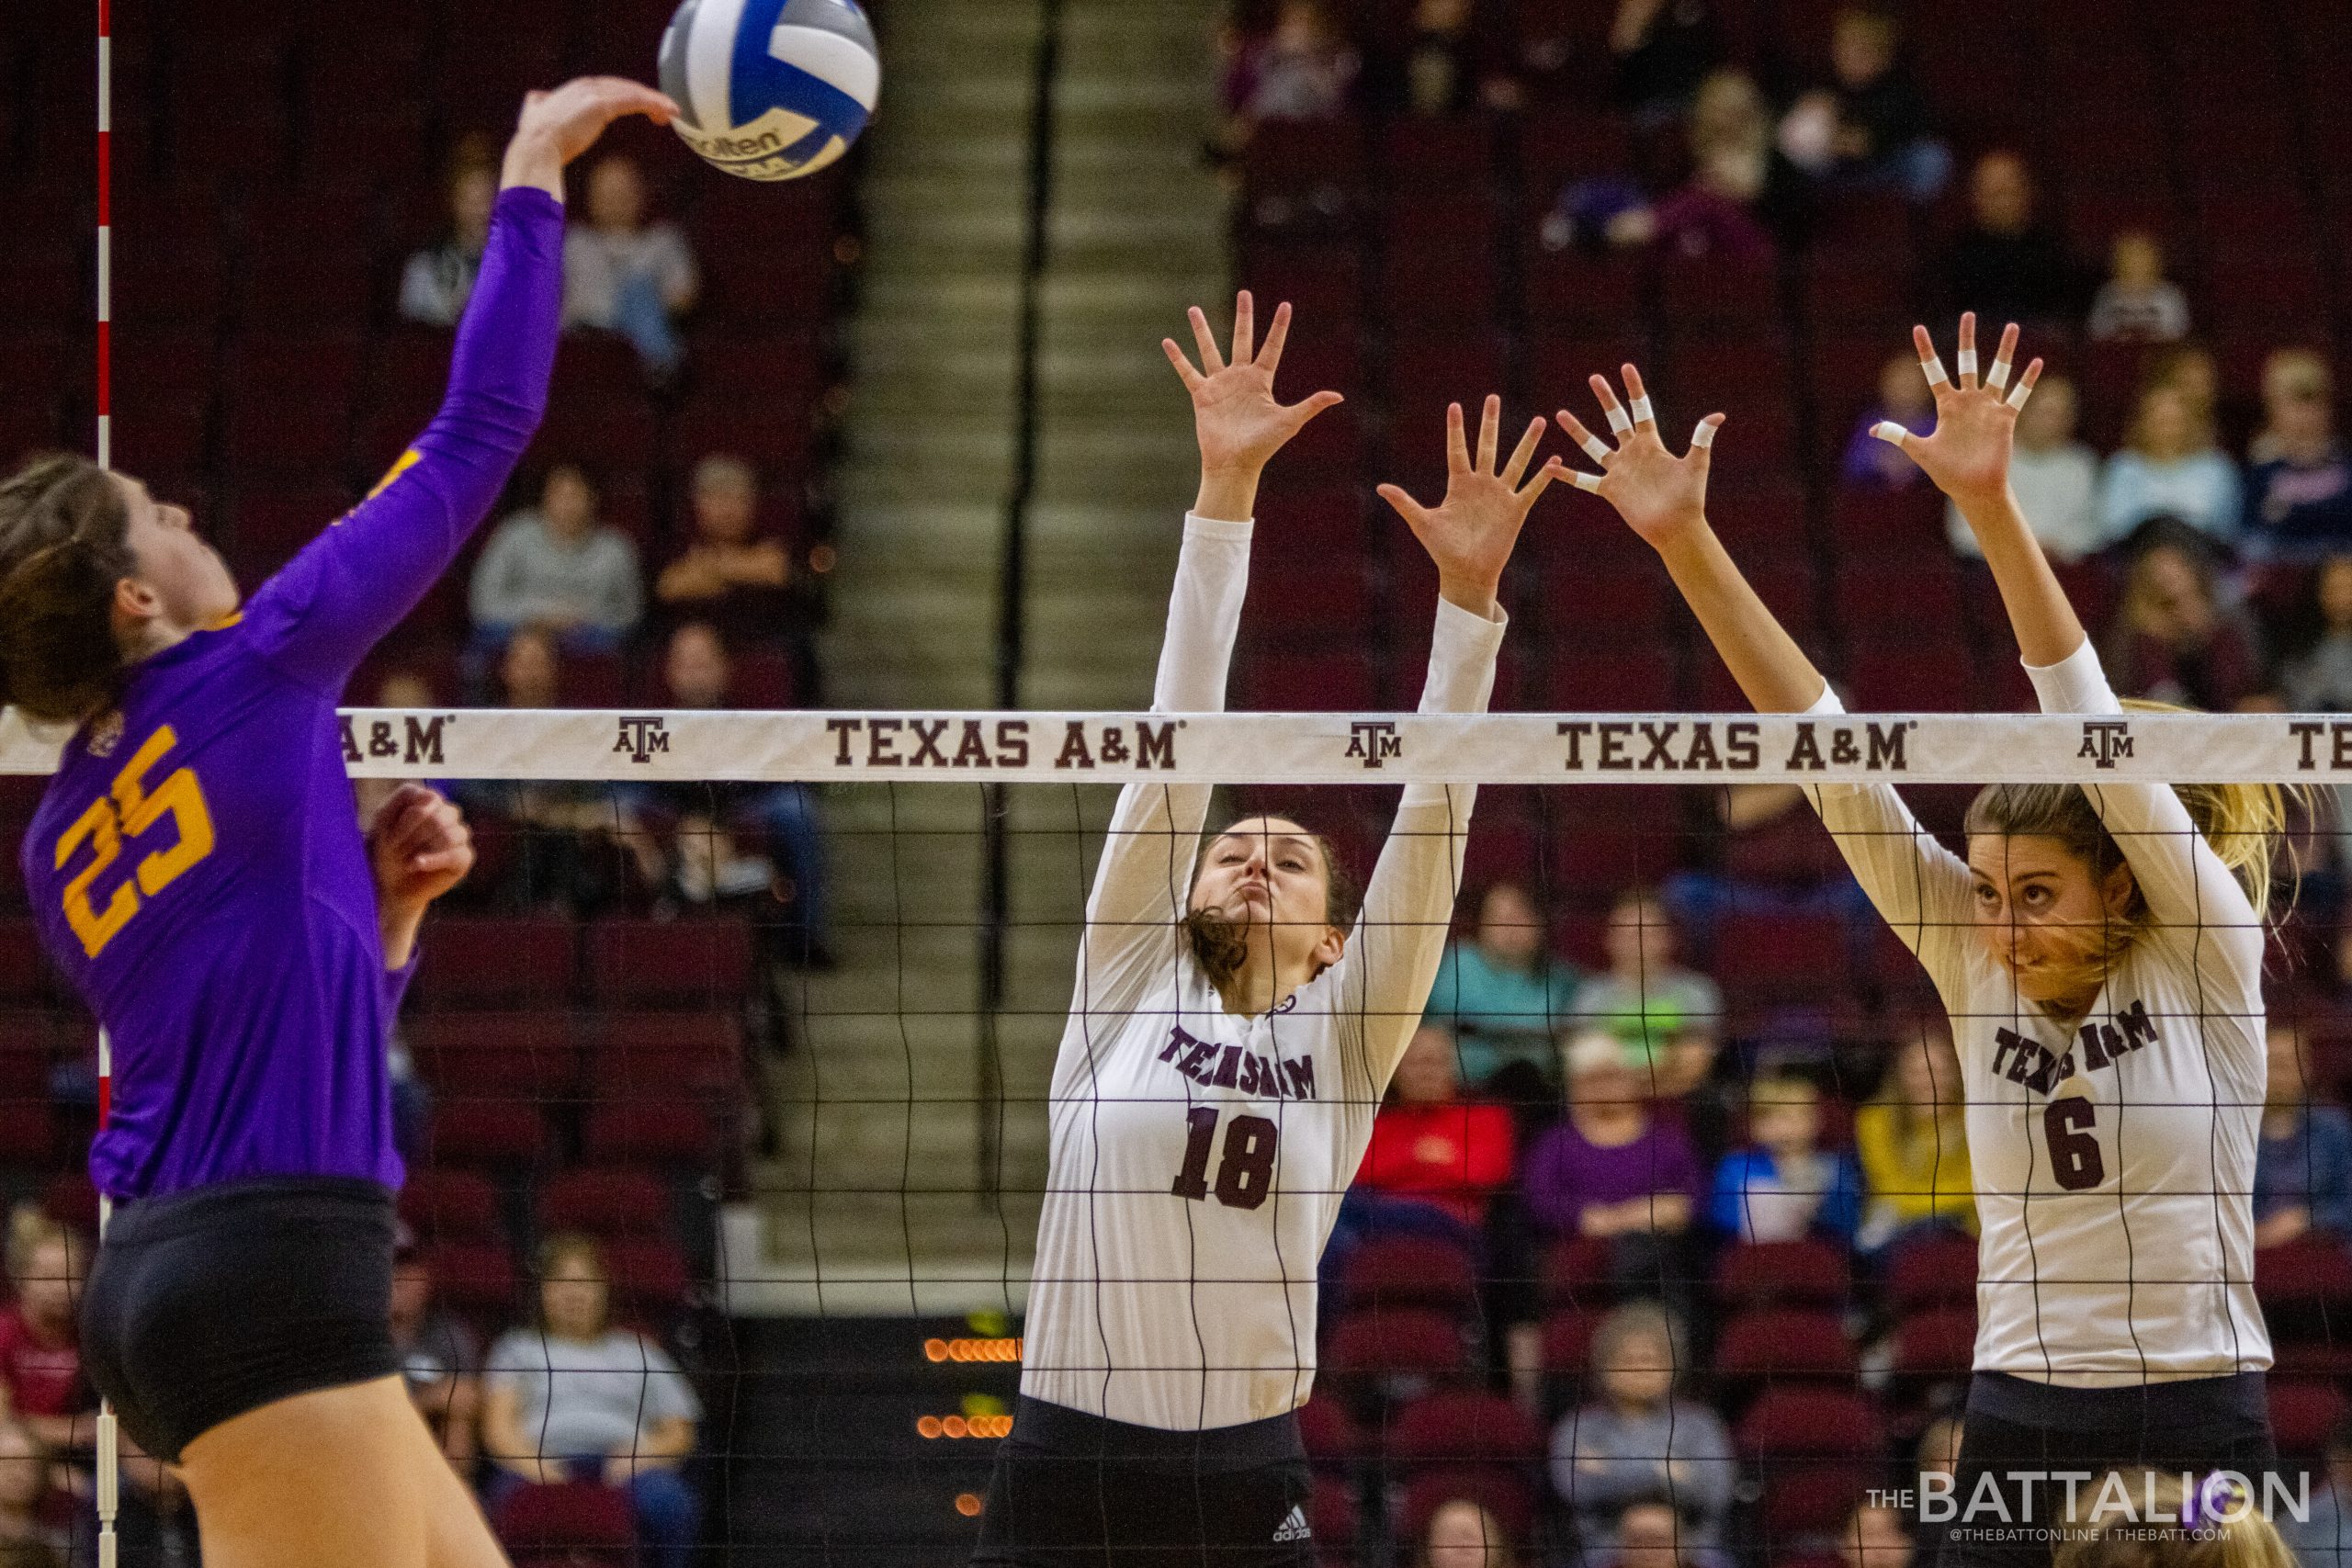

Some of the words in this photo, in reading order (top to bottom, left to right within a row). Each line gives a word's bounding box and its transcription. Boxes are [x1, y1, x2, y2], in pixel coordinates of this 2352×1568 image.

[826, 718, 1030, 769] TEXAS
[1054, 720, 1176, 770] A&M
[1556, 722, 1760, 771] TEXAS
[1785, 722, 1907, 771] A&M
[55, 724, 215, 959] 25
[1170, 1106, 1278, 1211] 18
[2043, 1096, 2105, 1191] 6
[1272, 1528, 1311, 1542] adidas
